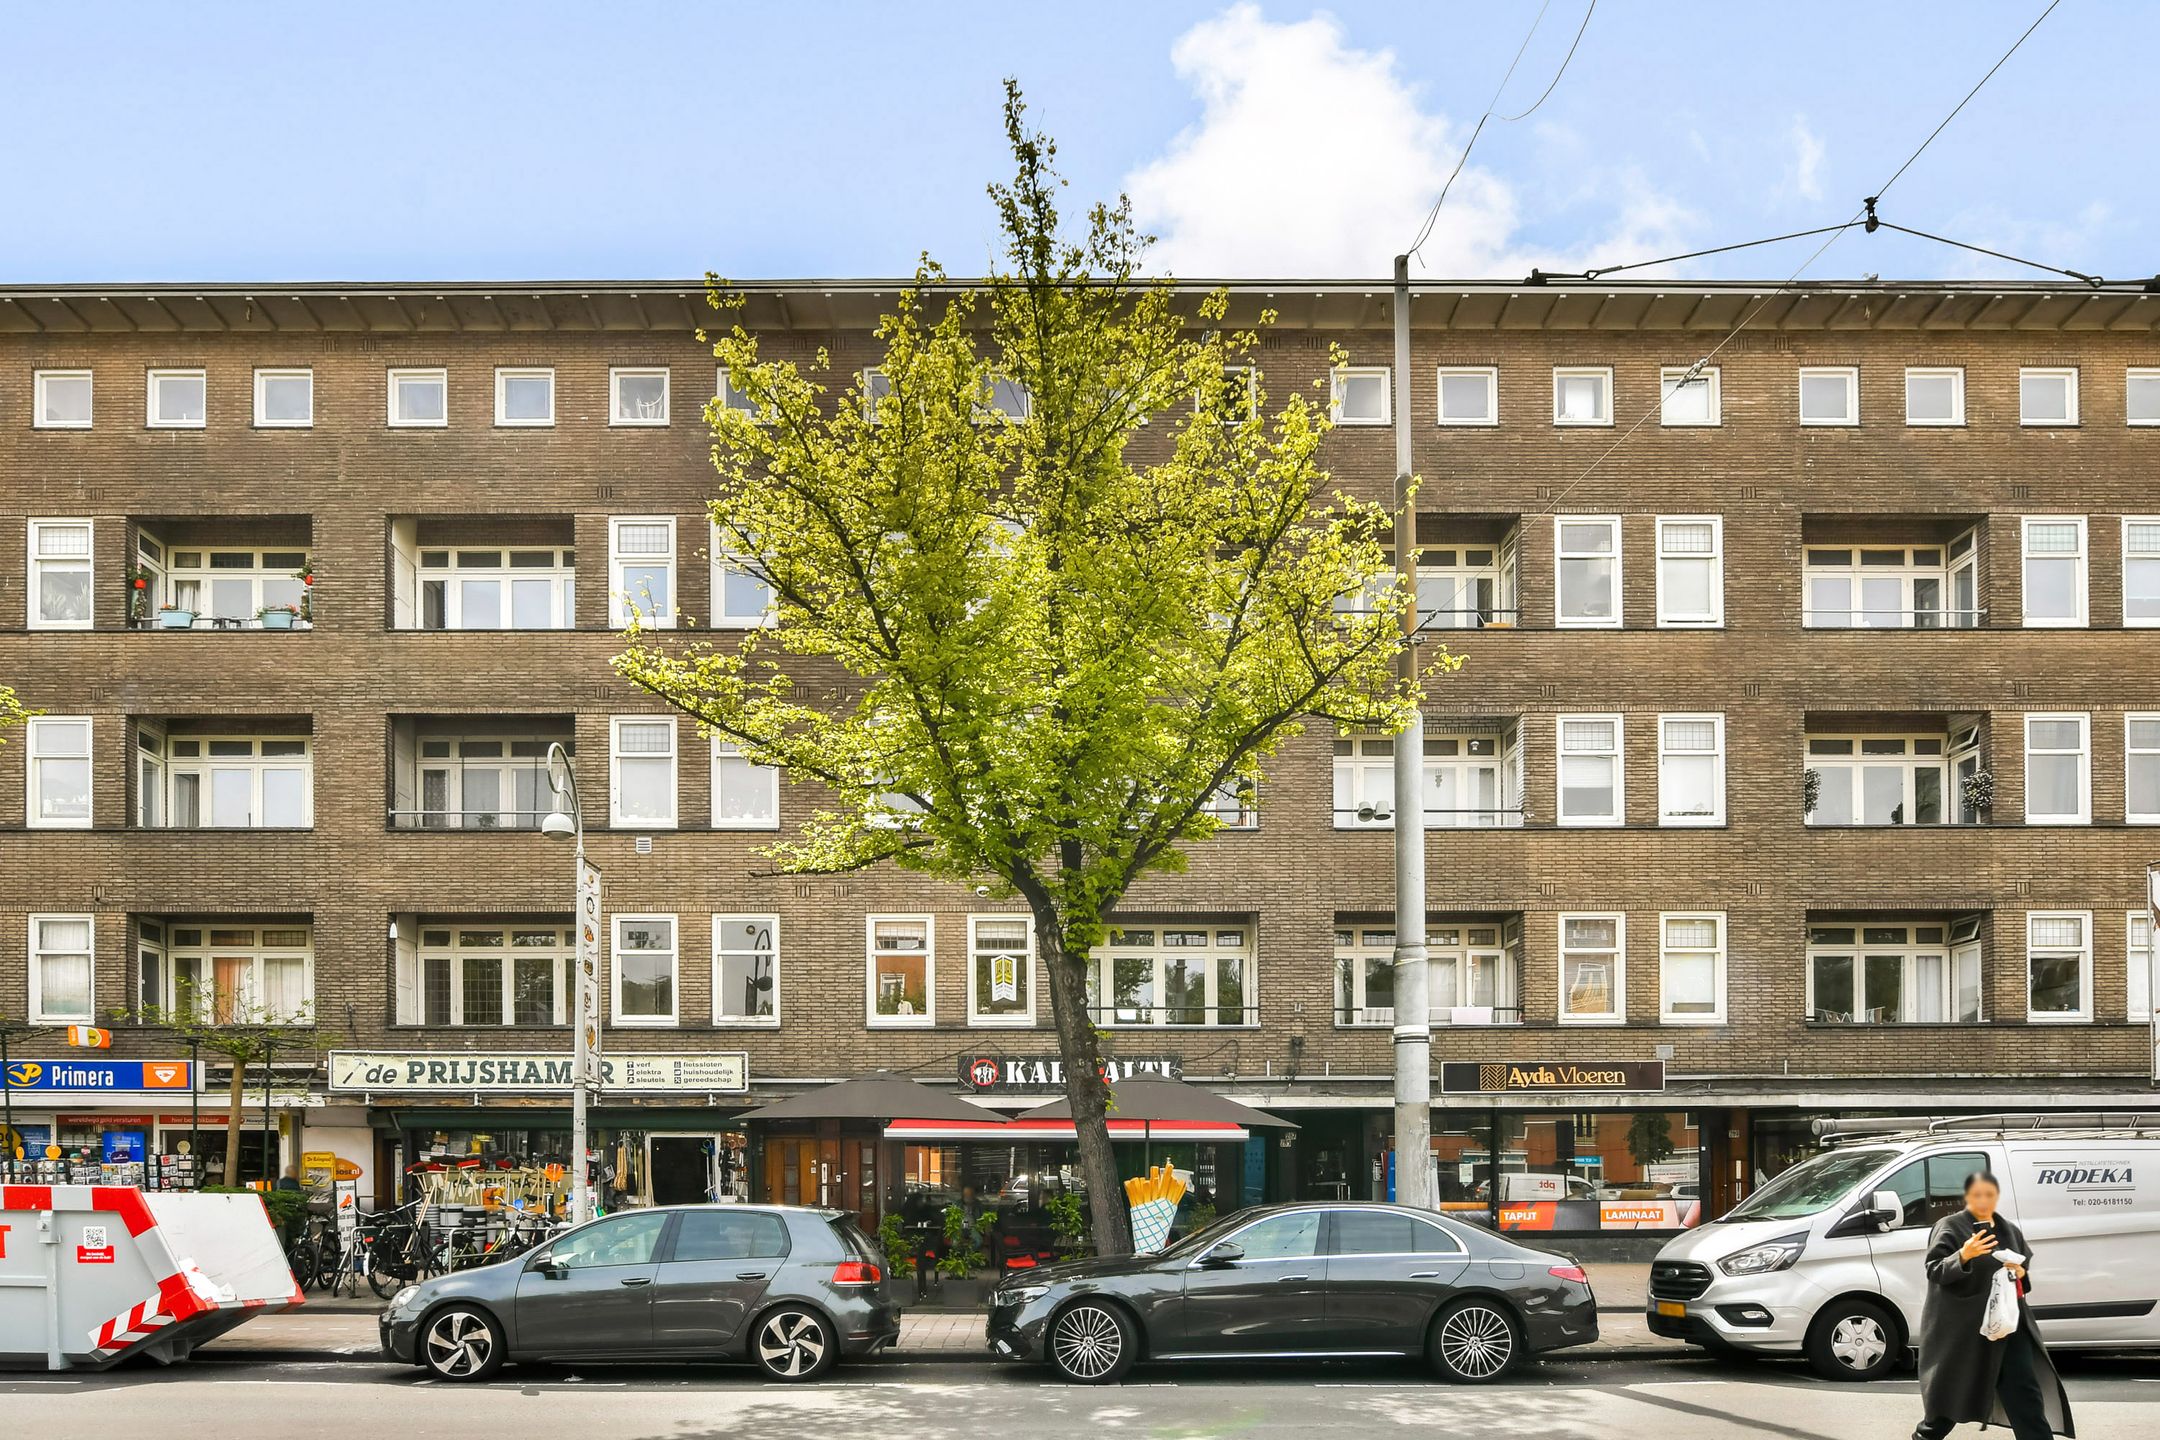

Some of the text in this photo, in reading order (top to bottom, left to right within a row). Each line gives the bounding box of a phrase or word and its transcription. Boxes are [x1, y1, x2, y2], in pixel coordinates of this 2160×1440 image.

[51, 1065, 114, 1087] Primera
[365, 1060, 615, 1084] de PRIJSHAMR
[1508, 1066, 1626, 1087] Ayda Vloeren
[2037, 1168, 2133, 1184] RODEKA
[2088, 1198, 2133, 1206] 020-6181150
[1503, 1212, 1538, 1220] TAPIJT
[1605, 1211, 1661, 1220] LAMINAAT
